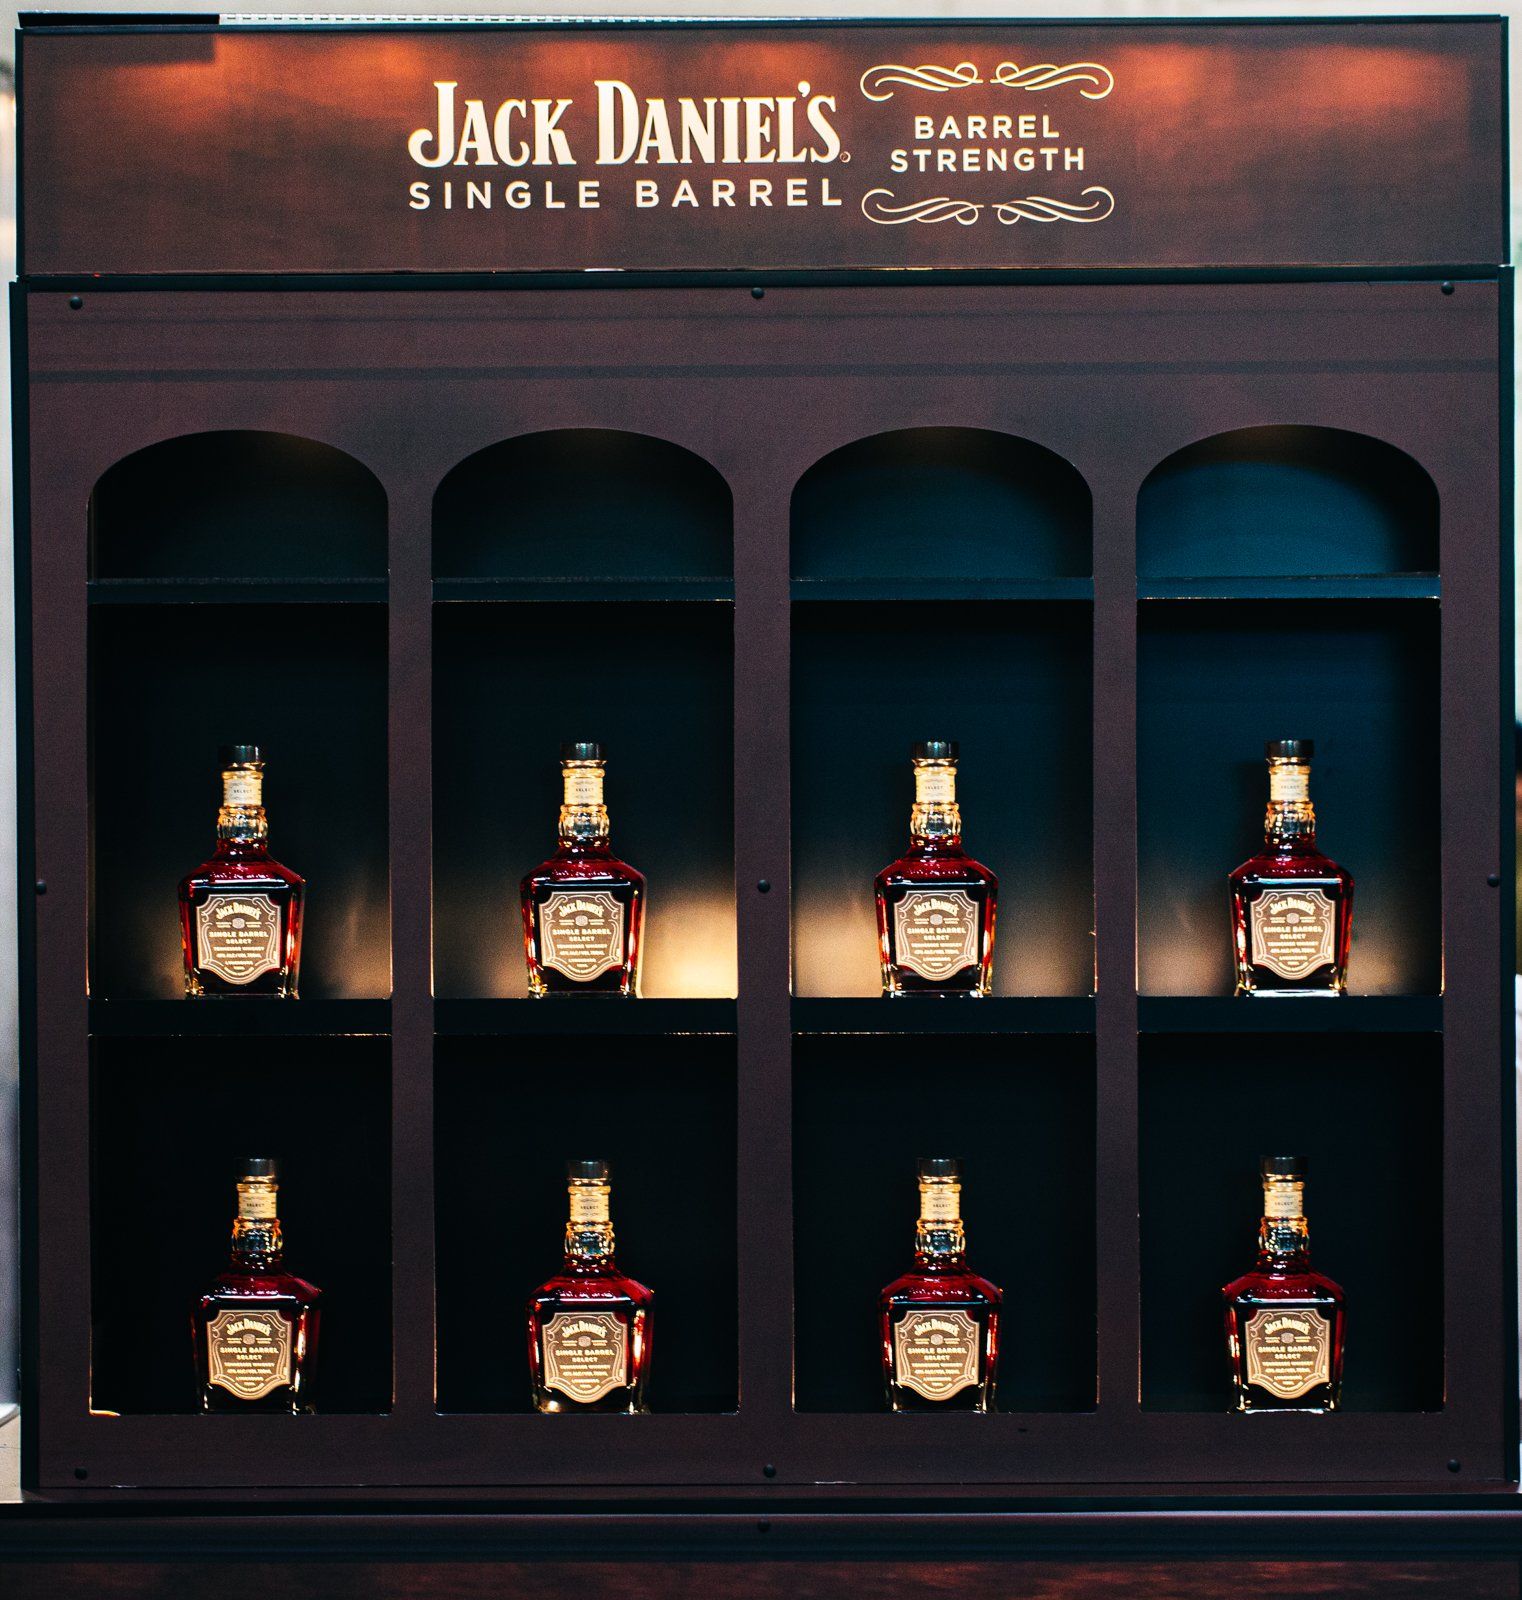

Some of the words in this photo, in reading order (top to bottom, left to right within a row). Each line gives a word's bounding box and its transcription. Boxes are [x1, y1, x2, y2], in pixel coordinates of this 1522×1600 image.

[915, 116, 1059, 138] BARREL
[891, 148, 1085, 172] STRENGTH
[409, 181, 600, 209] SINGLE
[636, 179, 842, 207] BARREL
